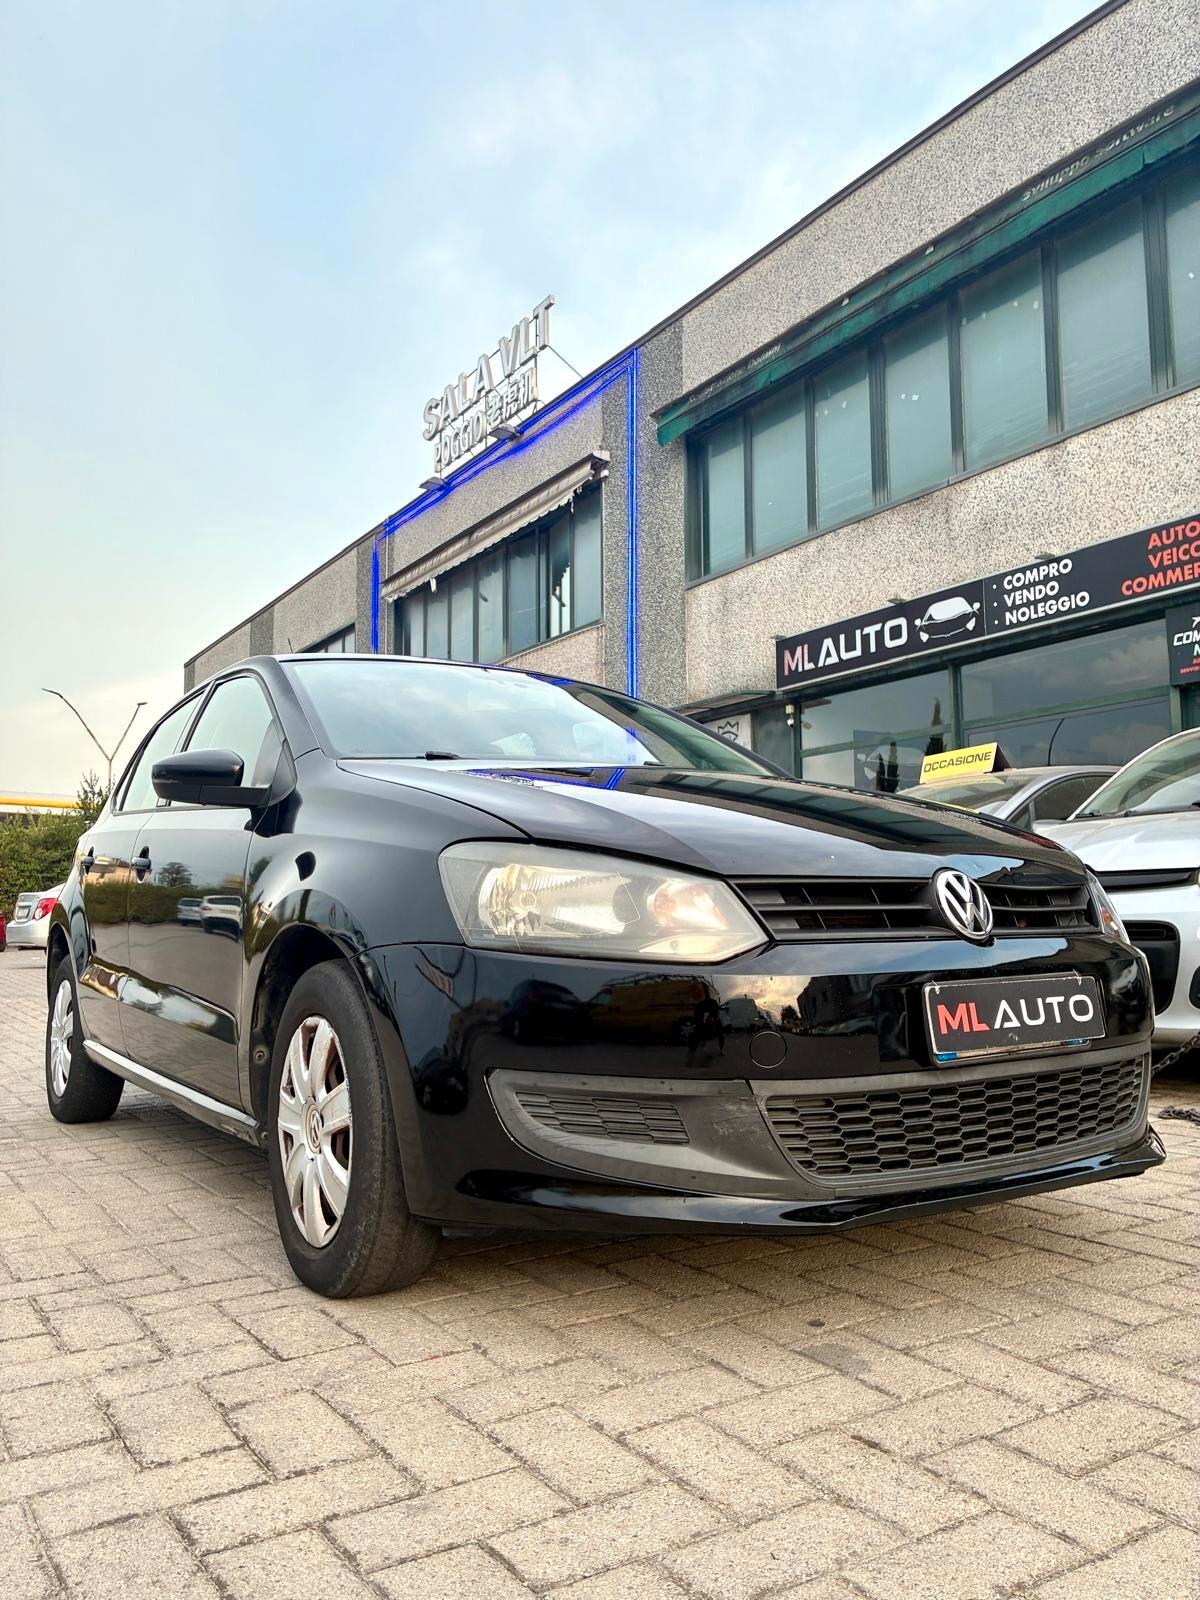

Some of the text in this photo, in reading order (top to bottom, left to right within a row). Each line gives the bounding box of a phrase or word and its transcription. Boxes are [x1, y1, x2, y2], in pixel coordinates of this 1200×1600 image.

[423, 294, 556, 441] SALA VLT
[434, 410, 487, 473] POGGIO
[1147, 520, 1200, 550] AUTO
[1003, 558, 1073, 590] COMPRO
[1003, 580, 1060, 608] VENDO
[1005, 591, 1090, 626] NOLEGGIO
[923, 751, 992, 773] OCCASIONE
